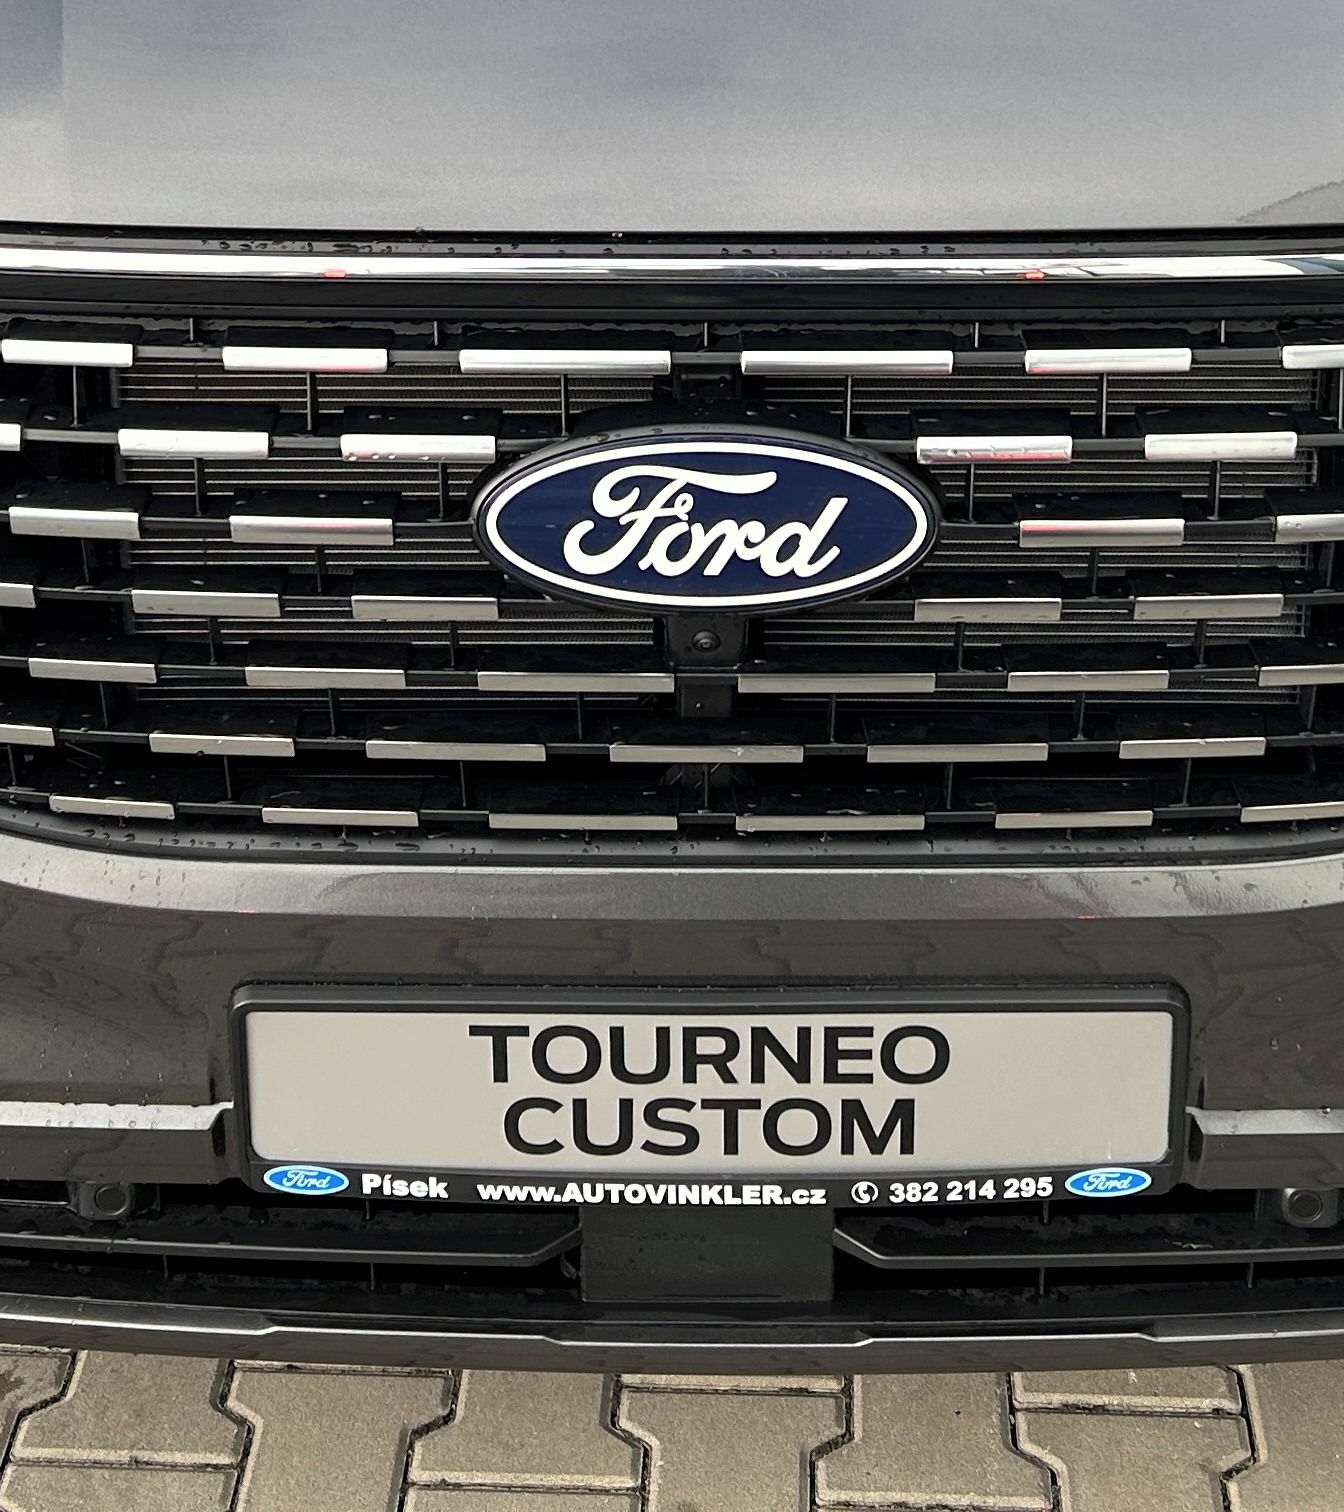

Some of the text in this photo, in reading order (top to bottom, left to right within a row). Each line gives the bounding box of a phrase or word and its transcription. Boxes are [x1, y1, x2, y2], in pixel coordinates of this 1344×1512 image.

[563, 464, 848, 578] Ford
[469, 1025, 951, 1085] TOURNEO
[503, 1097, 916, 1156] CUSTOM
[281, 1168, 1132, 1206] Ford Písek www.AUTOVINKLER.cz 382 214 295 Ford
